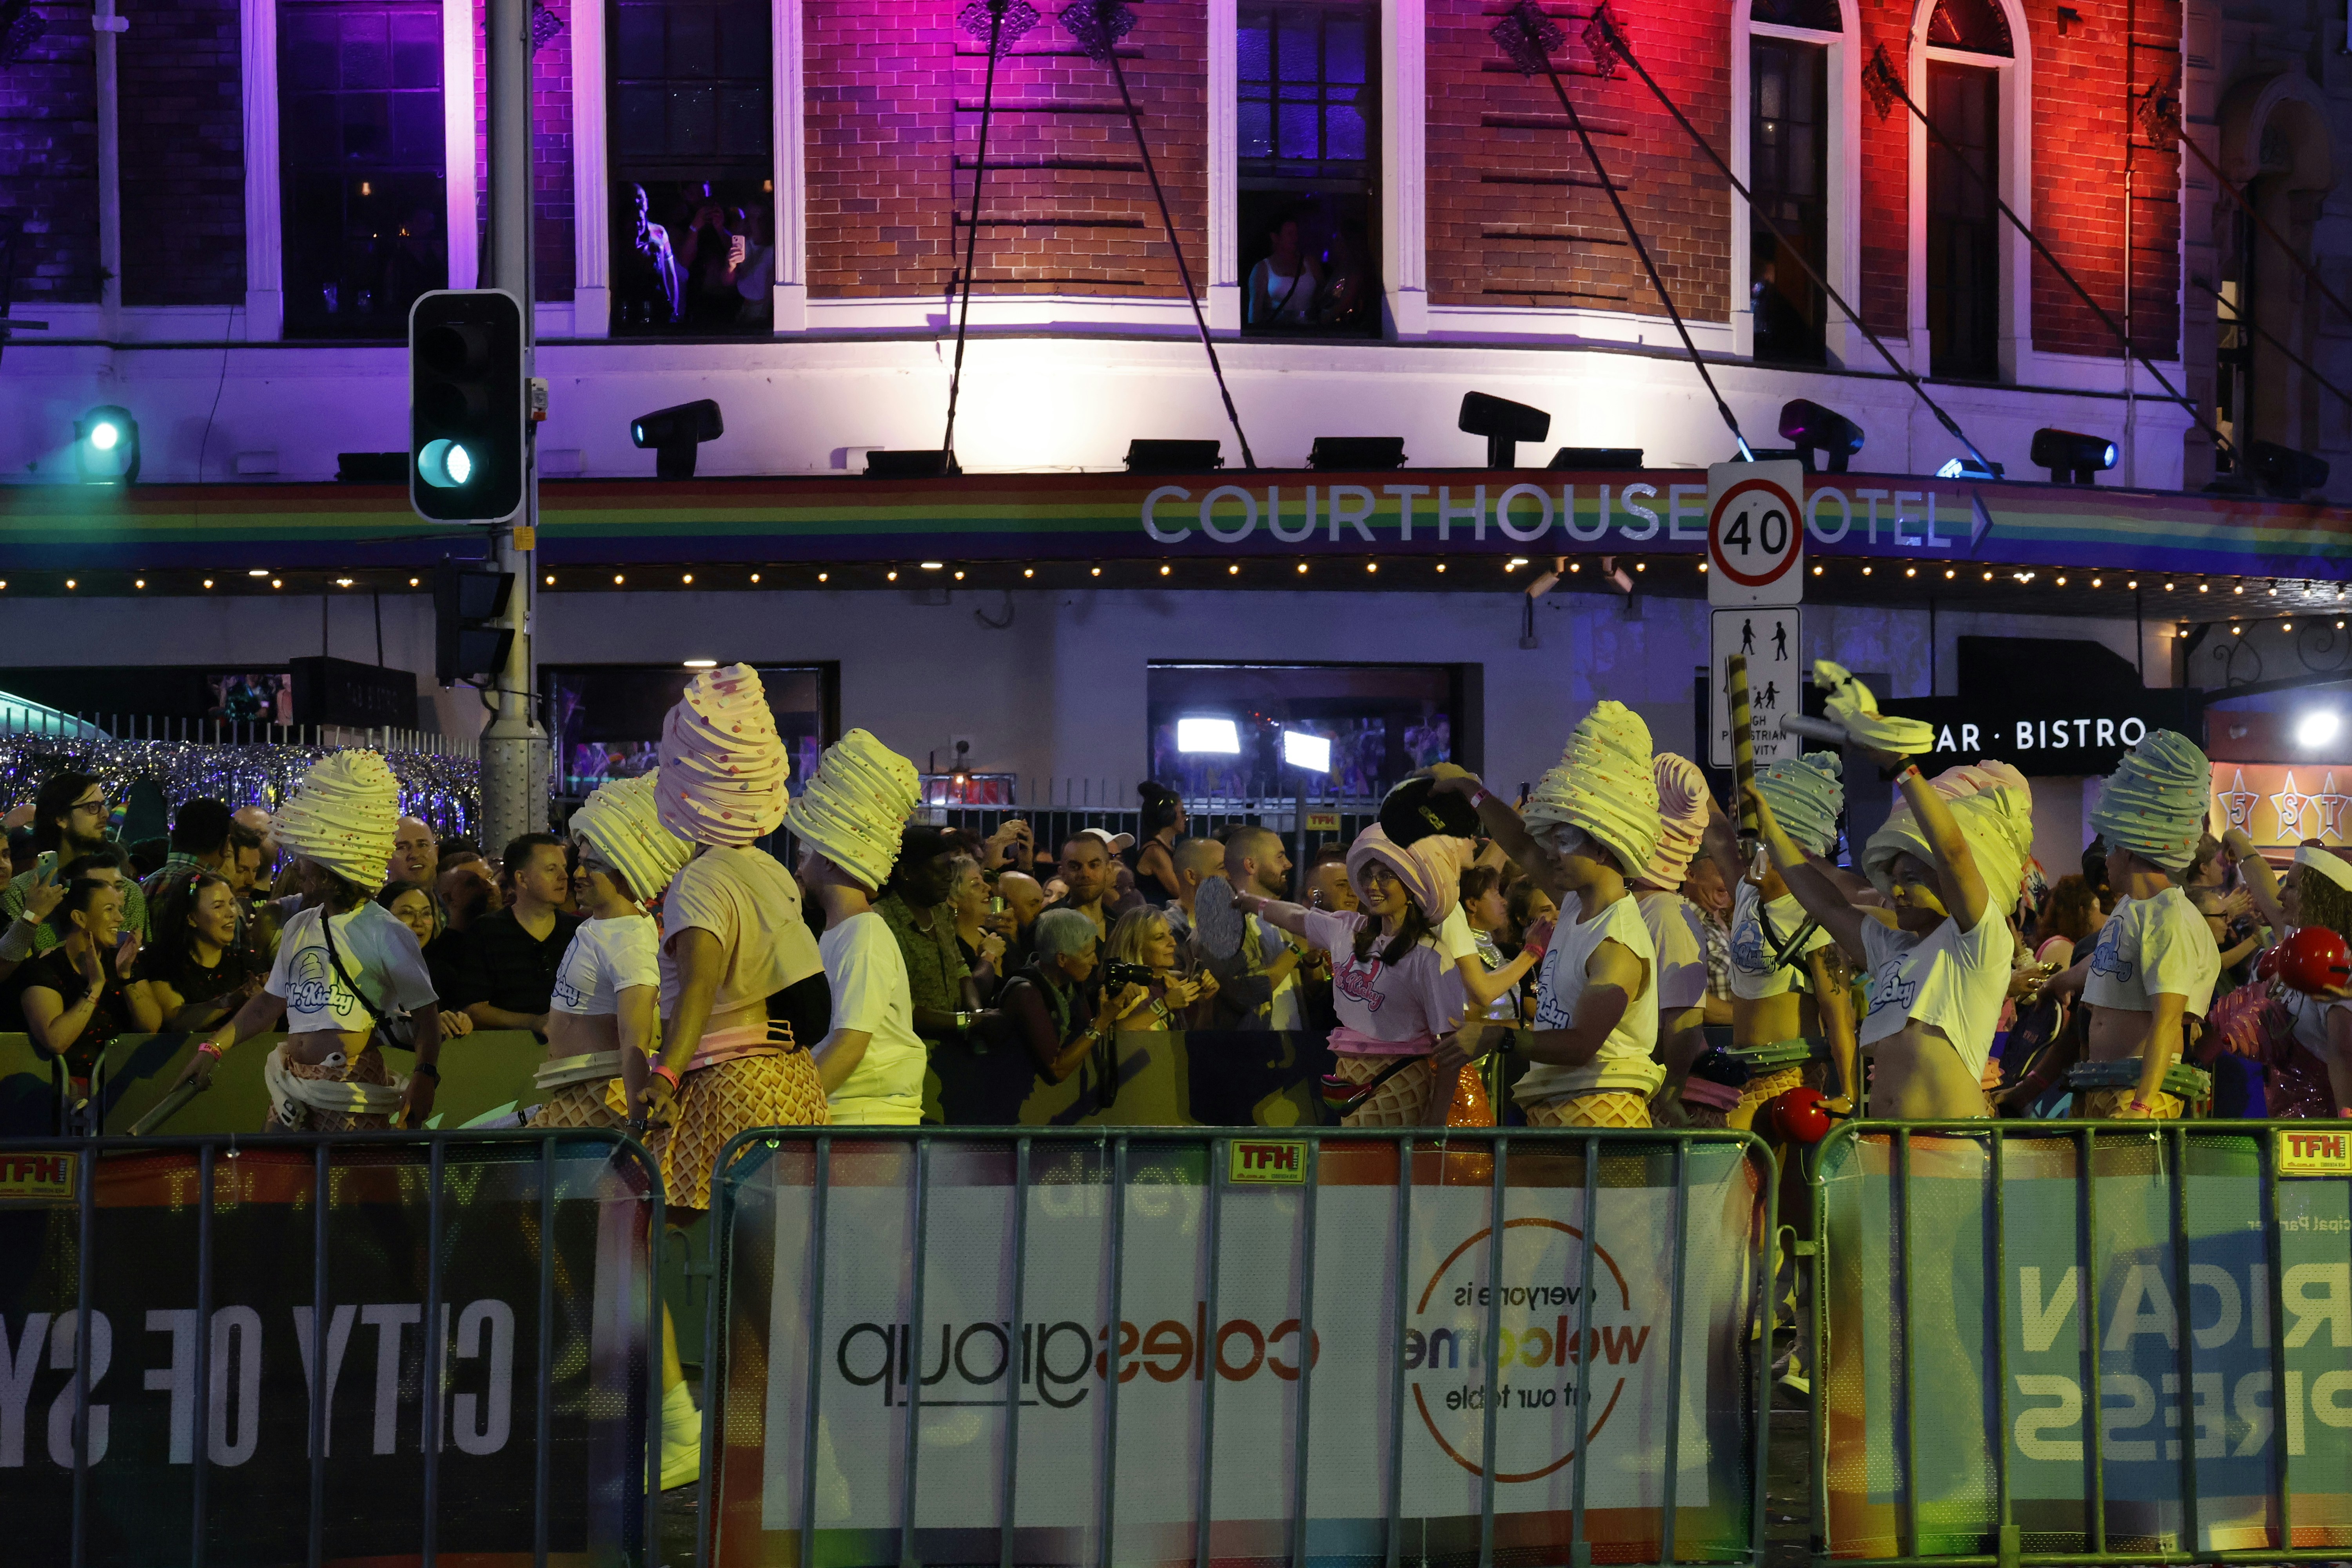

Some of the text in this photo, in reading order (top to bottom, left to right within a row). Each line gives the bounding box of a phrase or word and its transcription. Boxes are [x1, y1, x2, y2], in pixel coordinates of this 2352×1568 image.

[1141, 483, 1951, 548] COURTHOUSE OTEL
[1724, 510, 1787, 555] 40
[1722, 730, 1786, 740] PSTRIAN
[1935, 716, 2147, 753] AR BISTRO
[2230, 792, 2247, 825] 5
[1240, 1145, 1294, 1170] TFH
[2288, 1135, 2341, 1158] TFH
